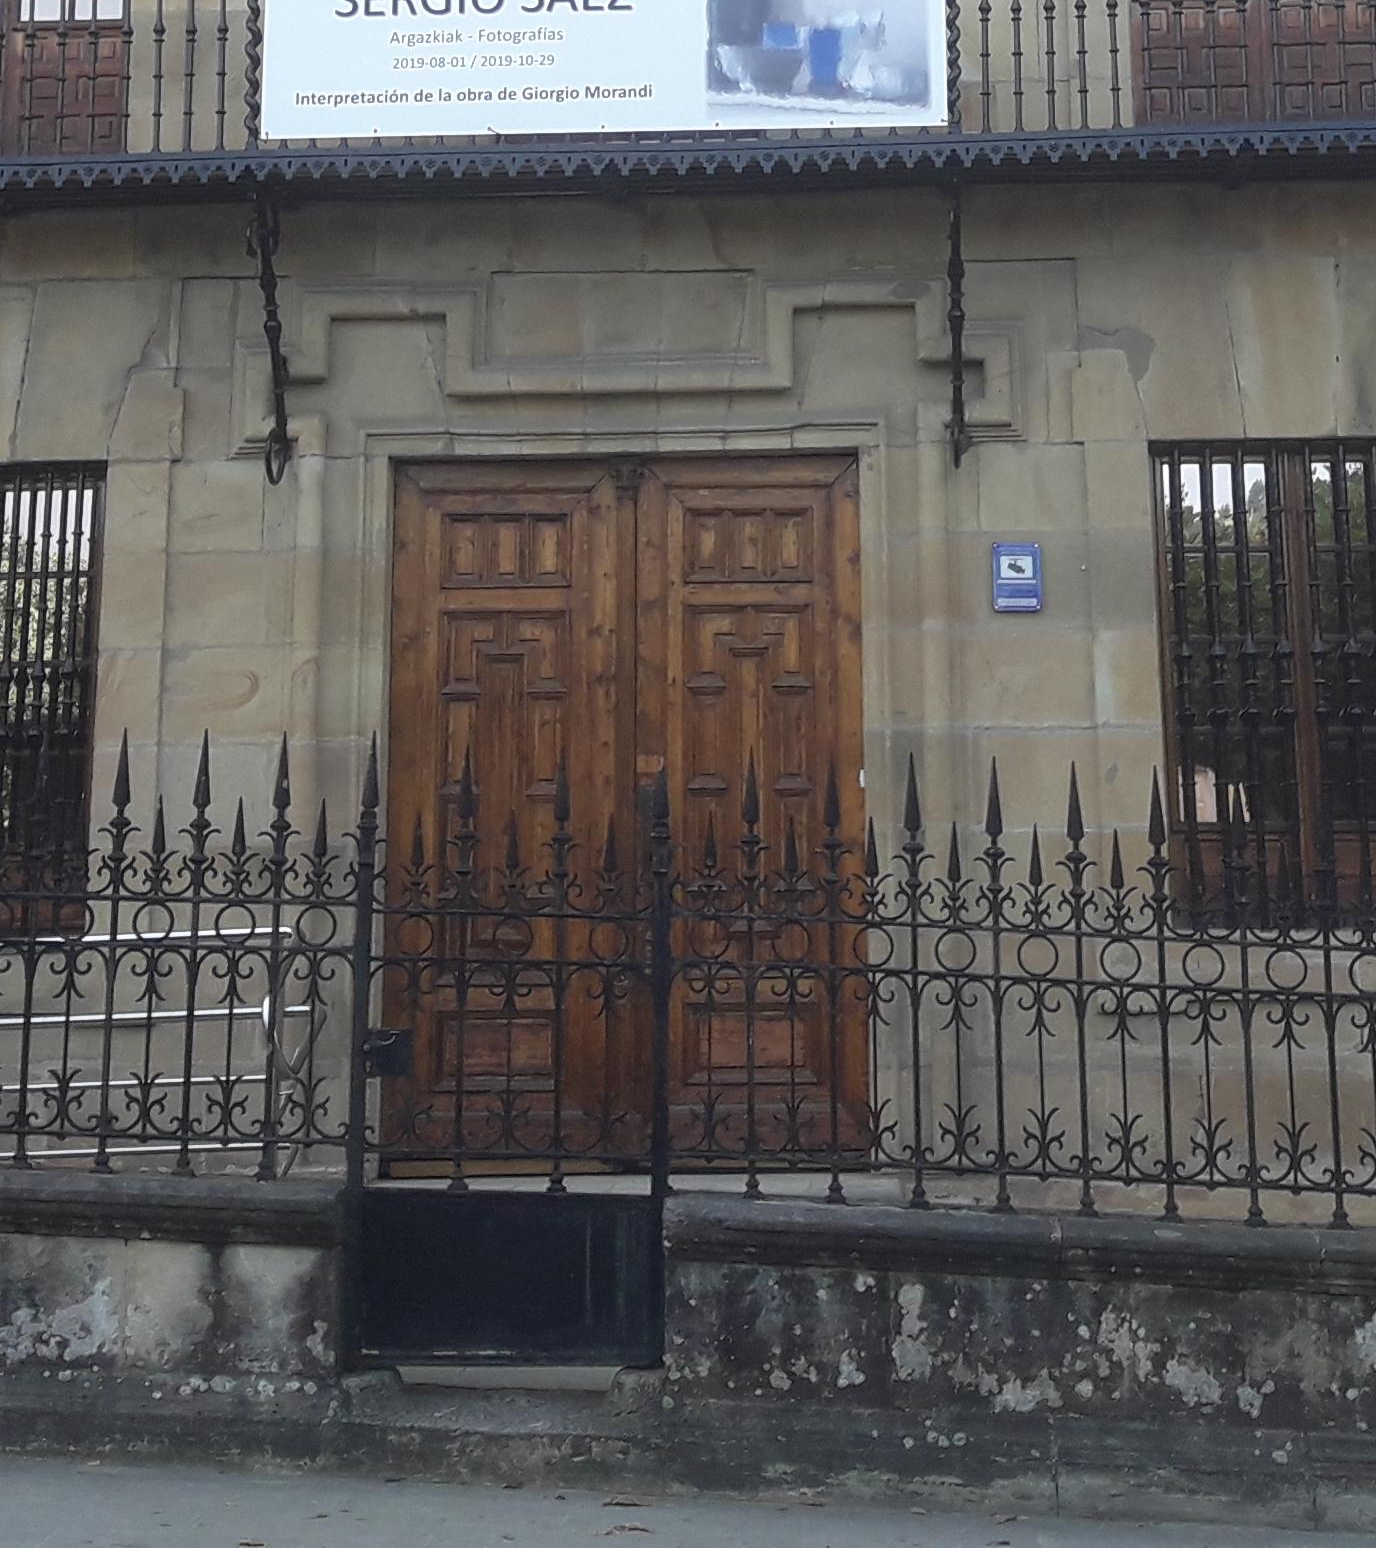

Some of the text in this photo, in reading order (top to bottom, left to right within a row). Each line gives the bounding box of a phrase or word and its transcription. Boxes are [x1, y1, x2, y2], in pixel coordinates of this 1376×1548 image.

[389, 29, 463, 47] Argazkiak
[477, 27, 565, 46] Fotografías
[392, 54, 556, 70] 2019-08-01 / 2019-10-29
[295, 84, 654, 107] Interpretación de la obra de Giorgio Morandi
